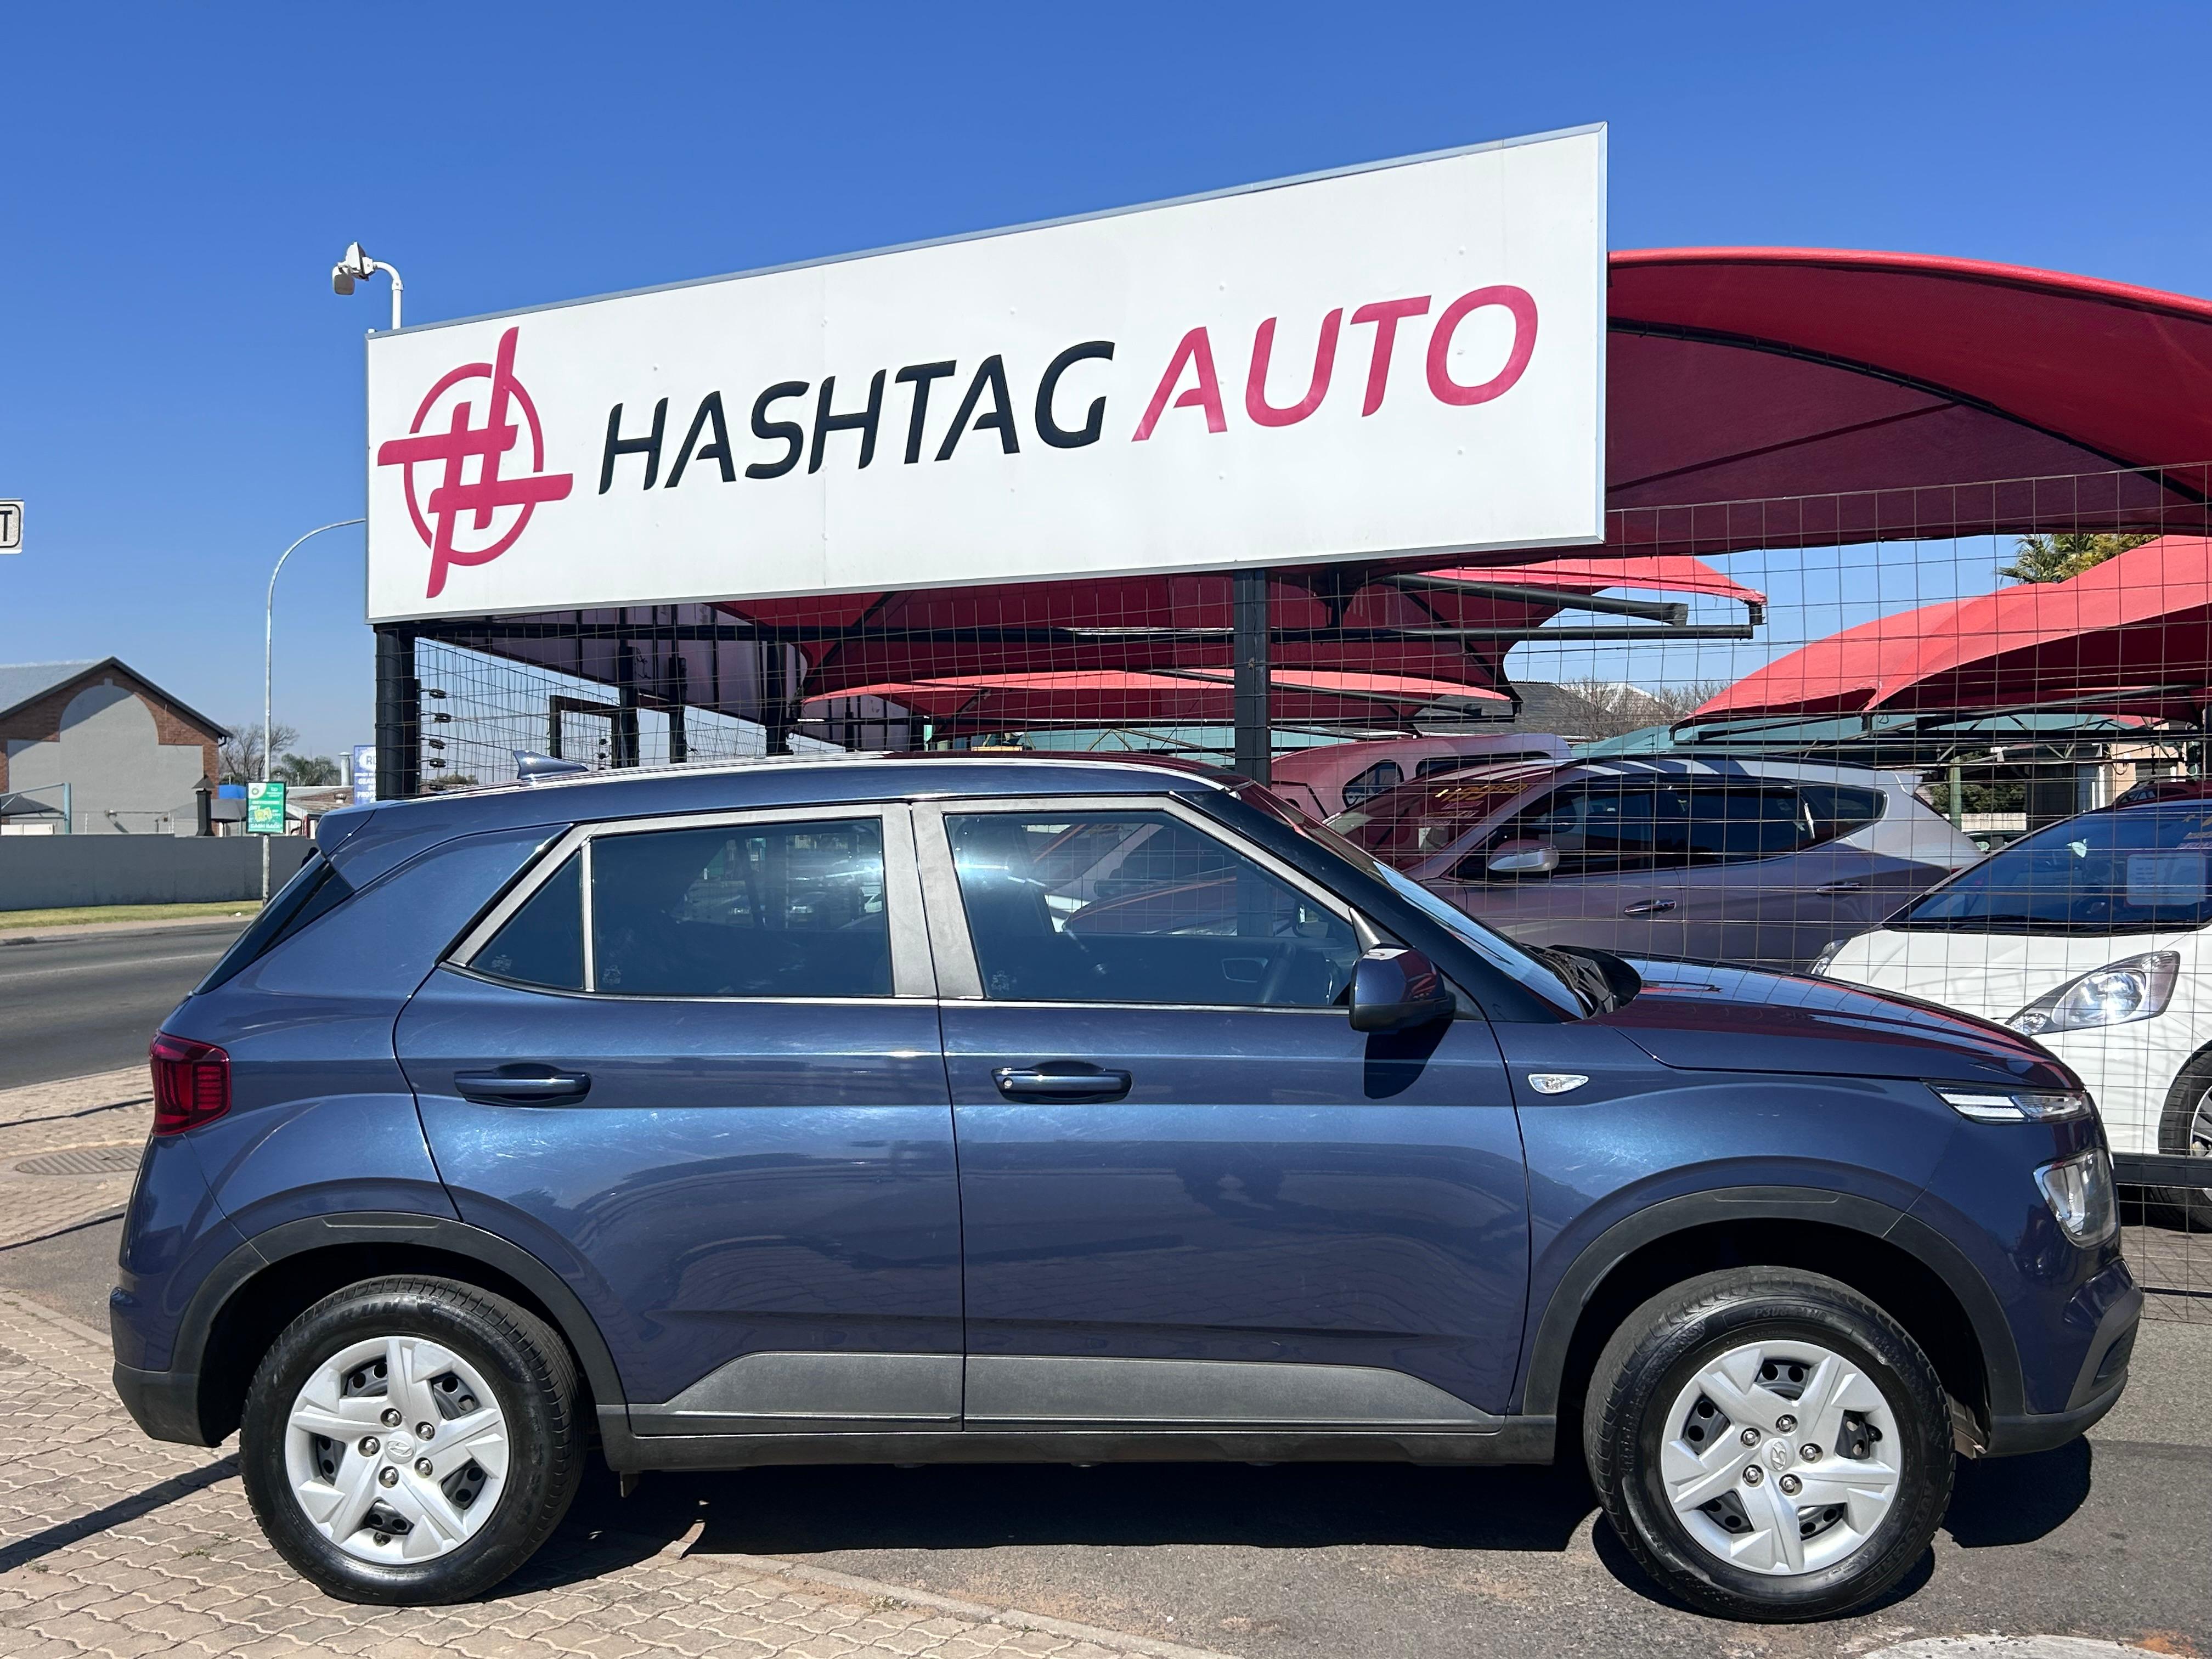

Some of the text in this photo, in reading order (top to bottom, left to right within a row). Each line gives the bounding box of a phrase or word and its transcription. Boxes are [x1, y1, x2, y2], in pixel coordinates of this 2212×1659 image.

[599, 285, 1538, 494] HASHTAG AUTO
[0, 510, 13, 541] T
